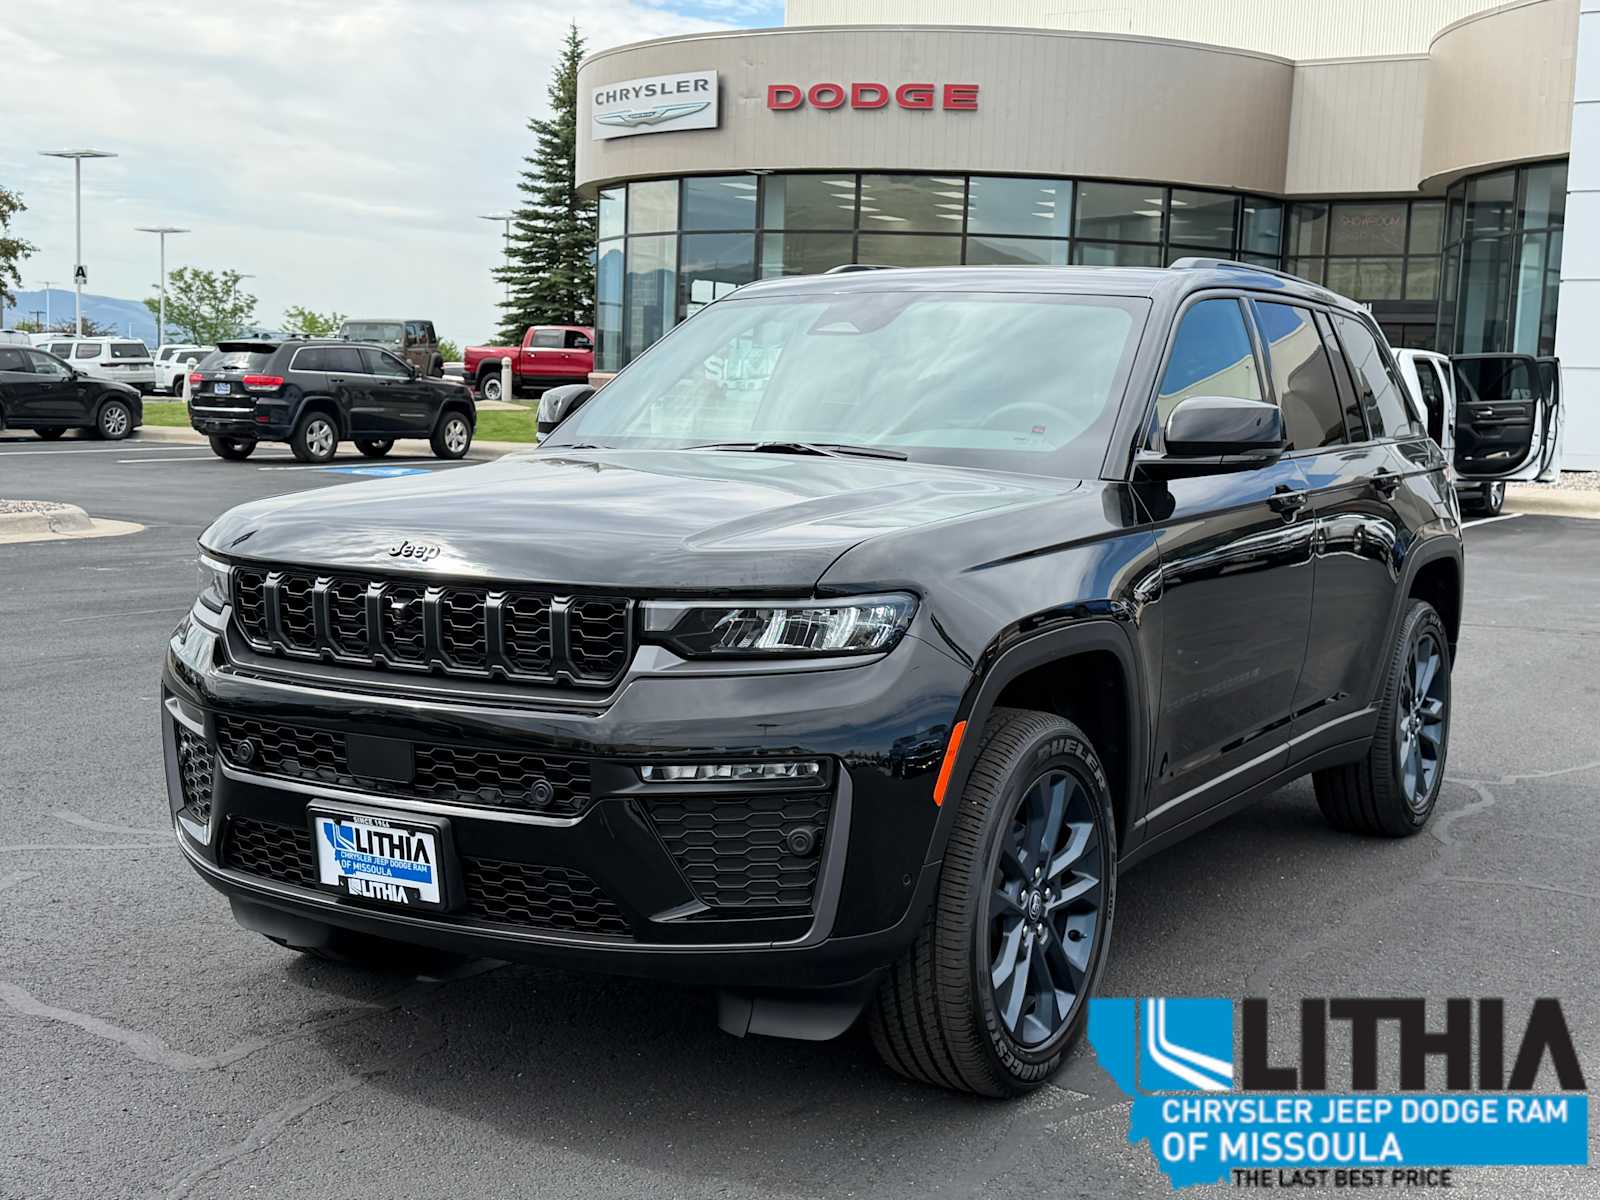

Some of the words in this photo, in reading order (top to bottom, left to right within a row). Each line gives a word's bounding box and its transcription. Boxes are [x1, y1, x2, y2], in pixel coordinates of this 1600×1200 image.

[594, 78, 709, 106] CHRYSLER
[766, 82, 980, 112] DODGE
[75, 265, 87, 278] A
[388, 540, 441, 562] Jeep
[355, 827, 431, 864] LITHIA
[340, 852, 372, 864] CHRYSLER
[373, 857, 389, 866] JEEP
[390, 860, 412, 872] DODGE
[413, 863, 428, 873] RAM
[341, 860, 352, 869] OF
[353, 862, 393, 877] MISSOULA
[362, 879, 409, 904] LITHIA
